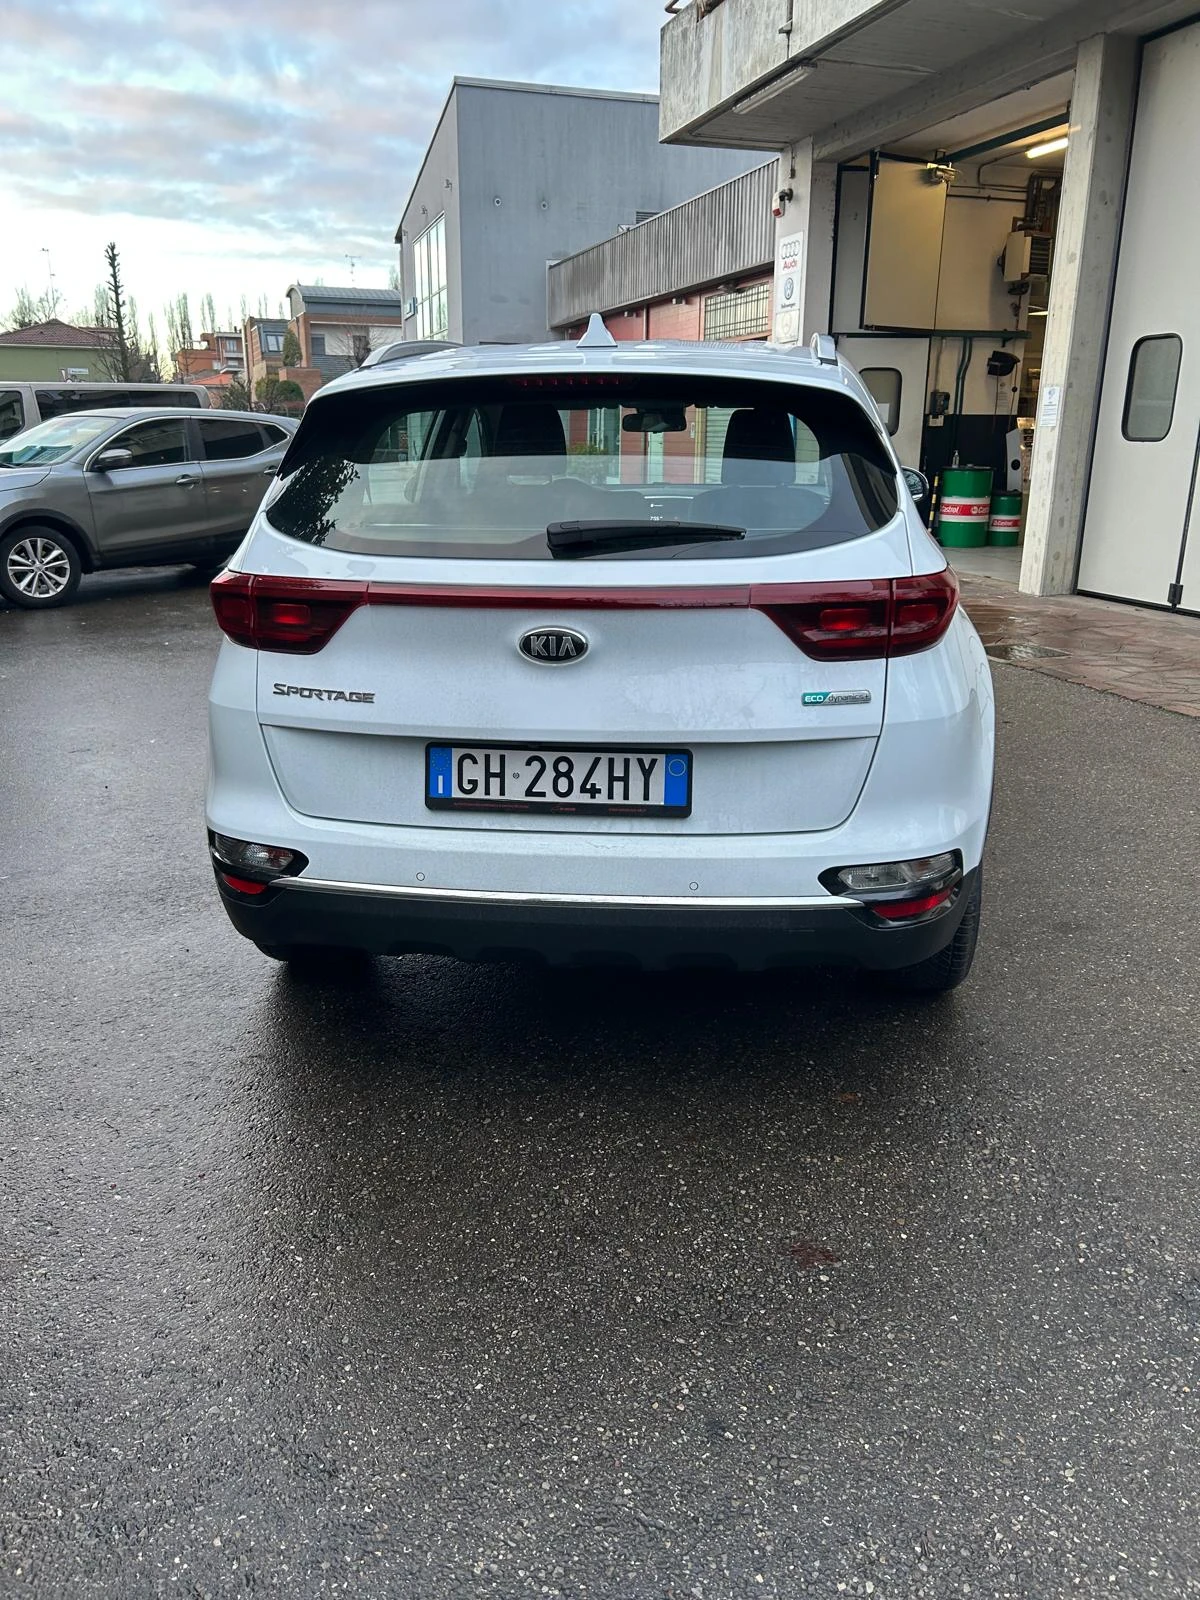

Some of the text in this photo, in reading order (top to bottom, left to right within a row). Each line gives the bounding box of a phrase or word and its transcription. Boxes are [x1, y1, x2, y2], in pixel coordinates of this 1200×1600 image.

[530, 635, 577, 656] KIA
[273, 682, 376, 704] SPORTAGE
[524, 755, 658, 801] 284HY
